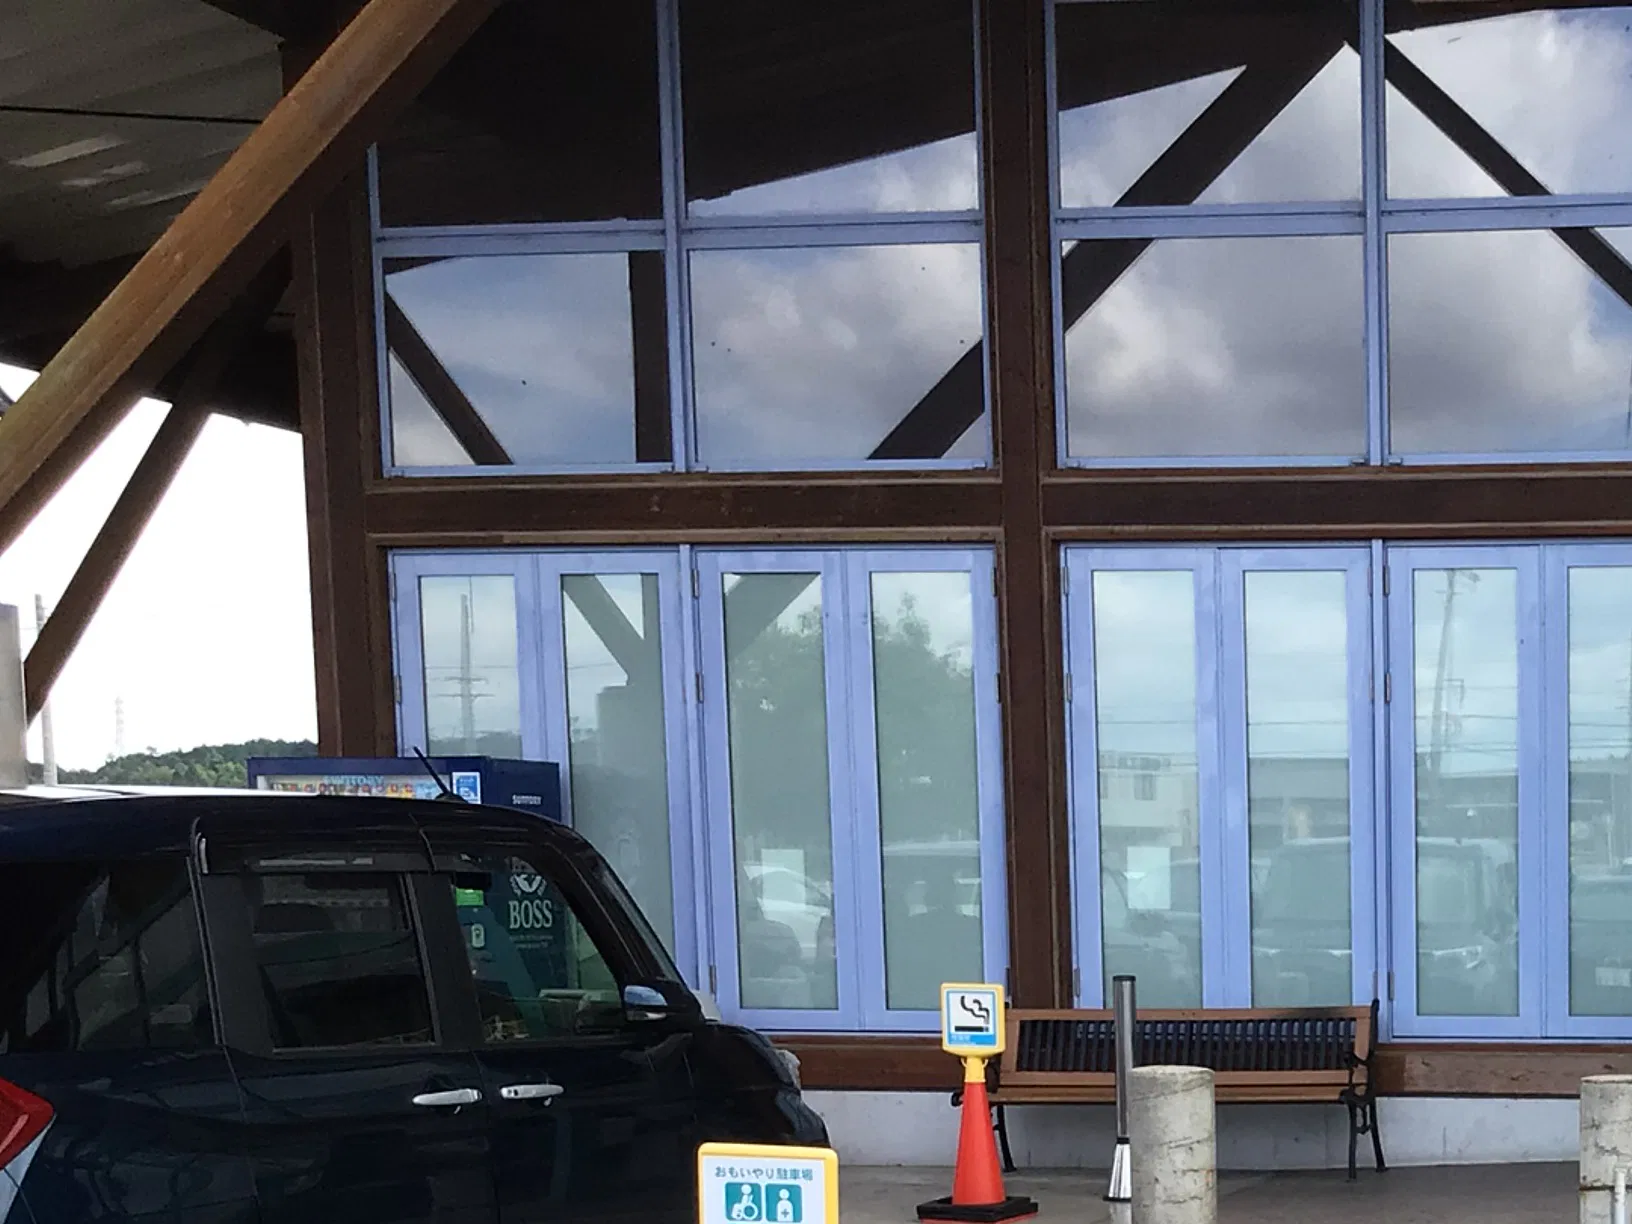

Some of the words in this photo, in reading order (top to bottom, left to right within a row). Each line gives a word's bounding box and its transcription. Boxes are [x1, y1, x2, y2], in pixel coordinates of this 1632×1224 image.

[508, 899, 553, 929] BOSS
[714, 1165, 814, 1182] おもいやり駐車場
